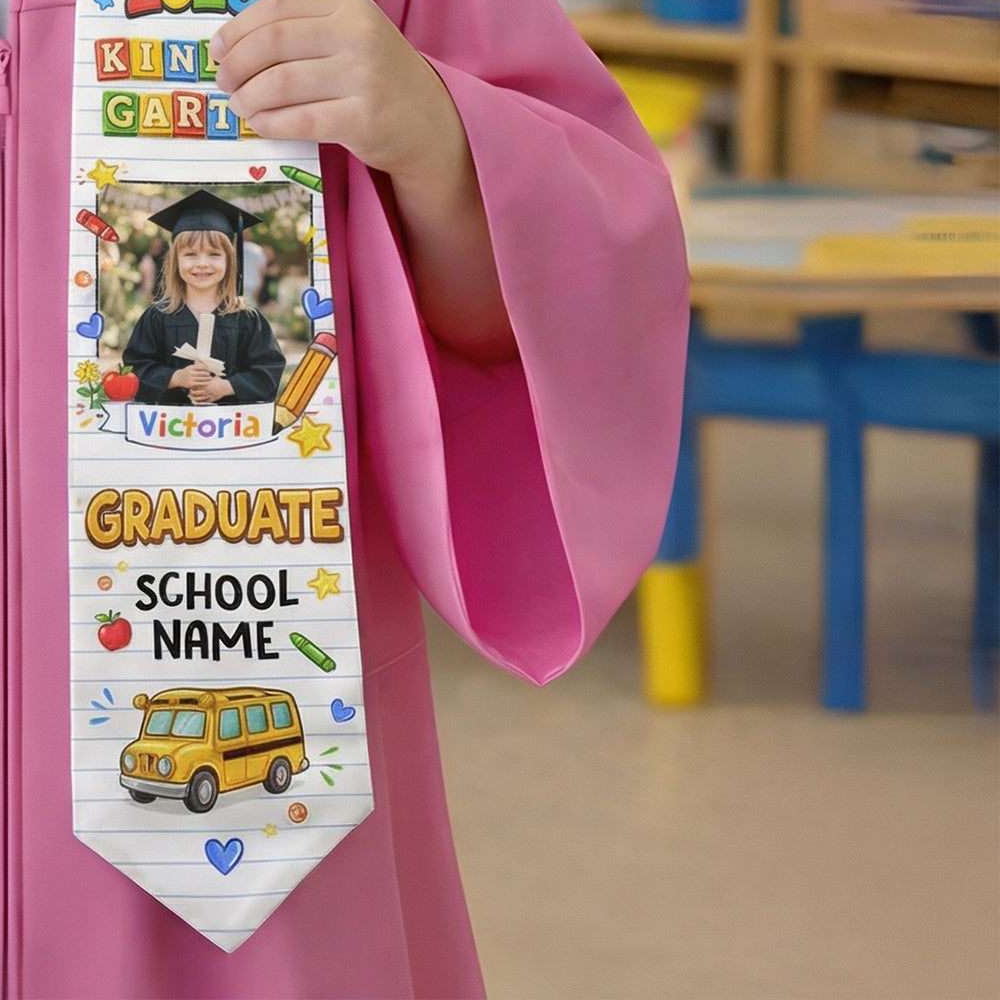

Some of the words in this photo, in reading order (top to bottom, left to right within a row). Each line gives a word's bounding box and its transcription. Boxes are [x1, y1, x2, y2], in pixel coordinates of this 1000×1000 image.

[105, 94, 250, 131] GART
[138, 410, 261, 438] Victoria
[85, 487, 345, 549] GRADUATE
[135, 569, 300, 611] SCHOOL
[153, 619, 280, 662] NAME
